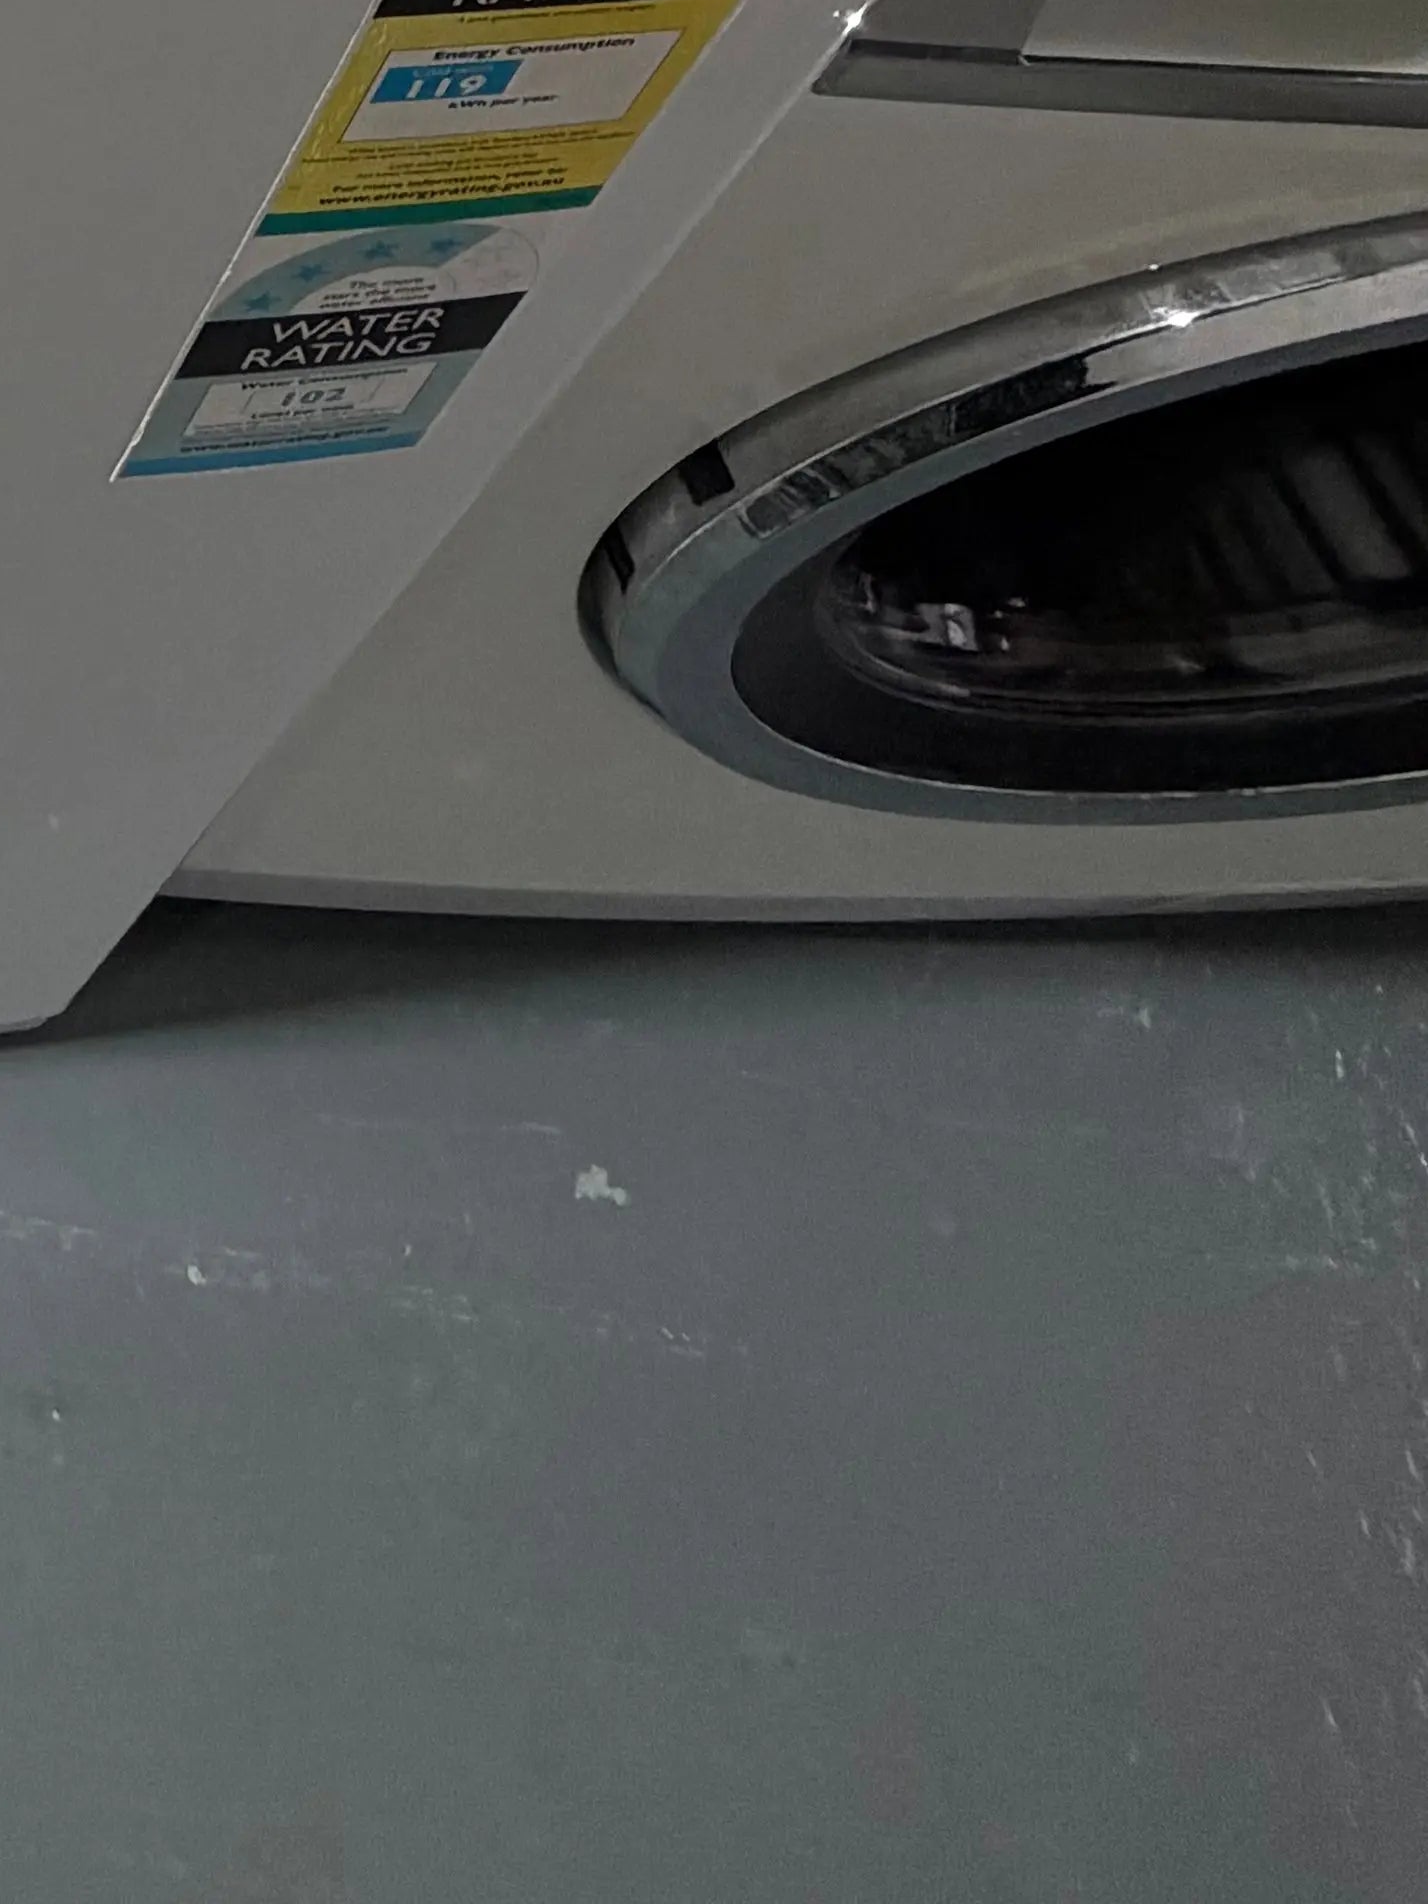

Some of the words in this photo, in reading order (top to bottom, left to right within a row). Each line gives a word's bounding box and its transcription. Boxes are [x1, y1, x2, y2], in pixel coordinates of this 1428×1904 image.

[432, 47, 501, 62] Energy
[505, 37, 636, 58] Consumption
[405, 75, 488, 99] 119
[273, 307, 446, 344] WATER
[241, 333, 437, 371] RATING
